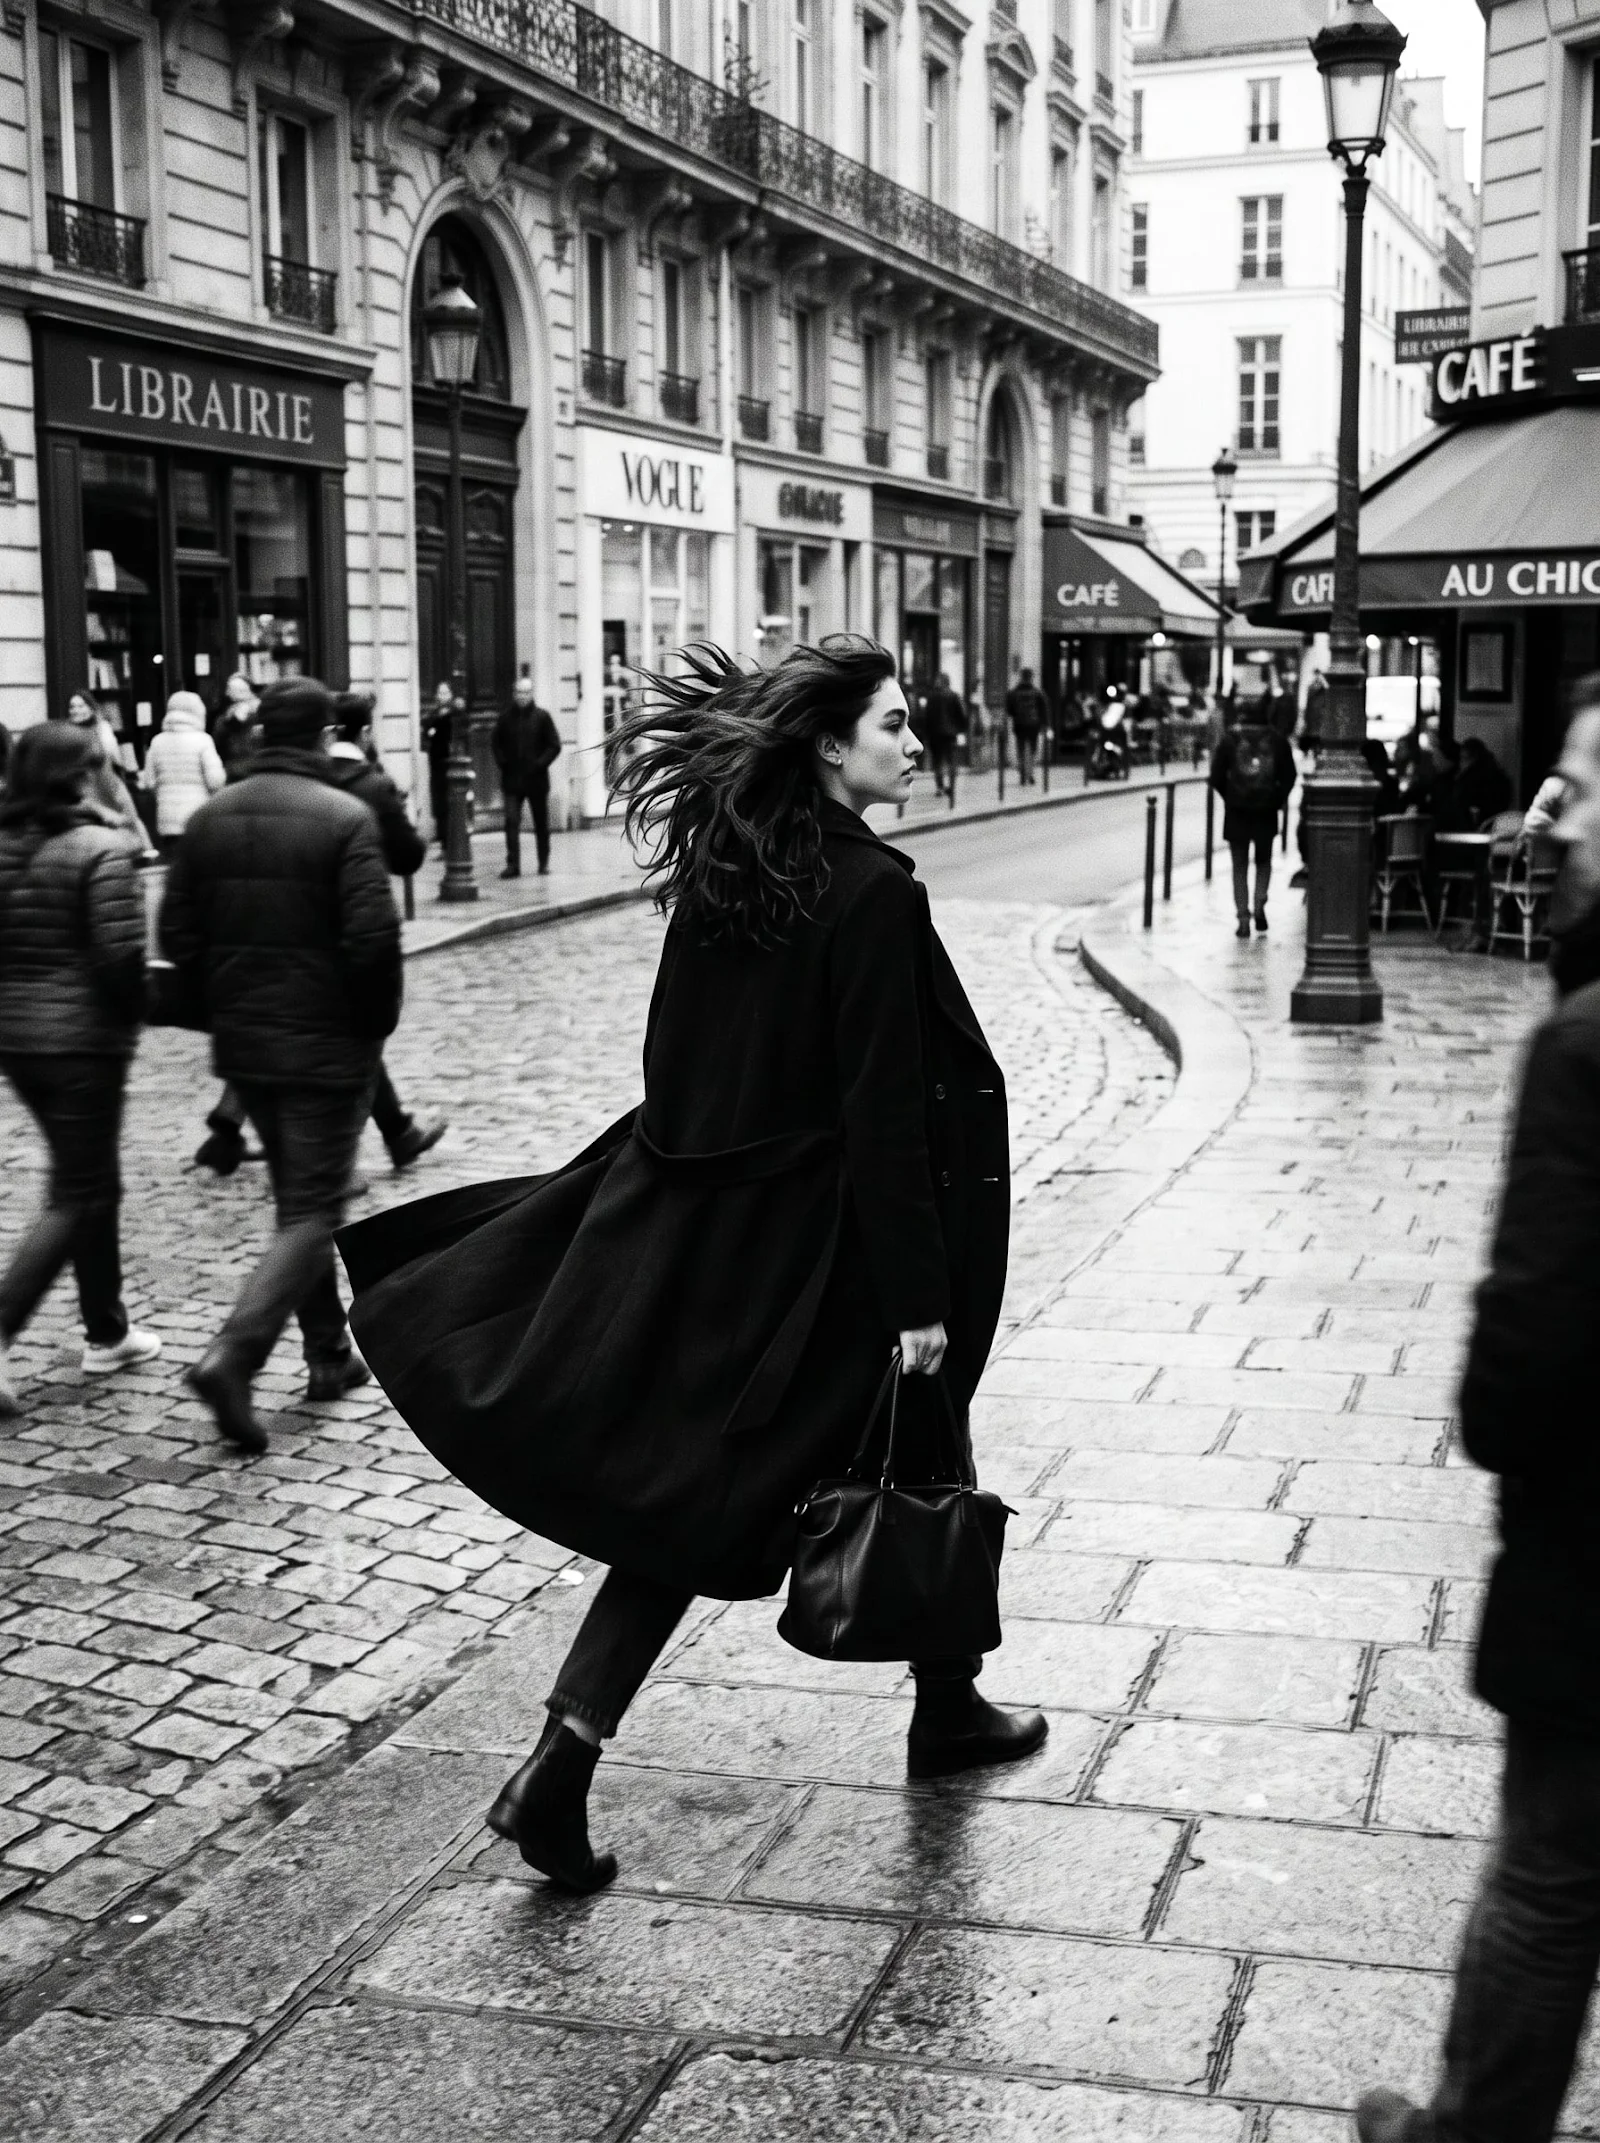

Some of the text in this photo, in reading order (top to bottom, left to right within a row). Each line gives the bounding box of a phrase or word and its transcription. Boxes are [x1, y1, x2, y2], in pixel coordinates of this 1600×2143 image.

[87, 355, 314, 445] LIBRAIRIE
[621, 451, 704, 513] VOGUE
[1057, 579, 1120, 607] CAFÉ
[1441, 563, 1494, 597] AU
